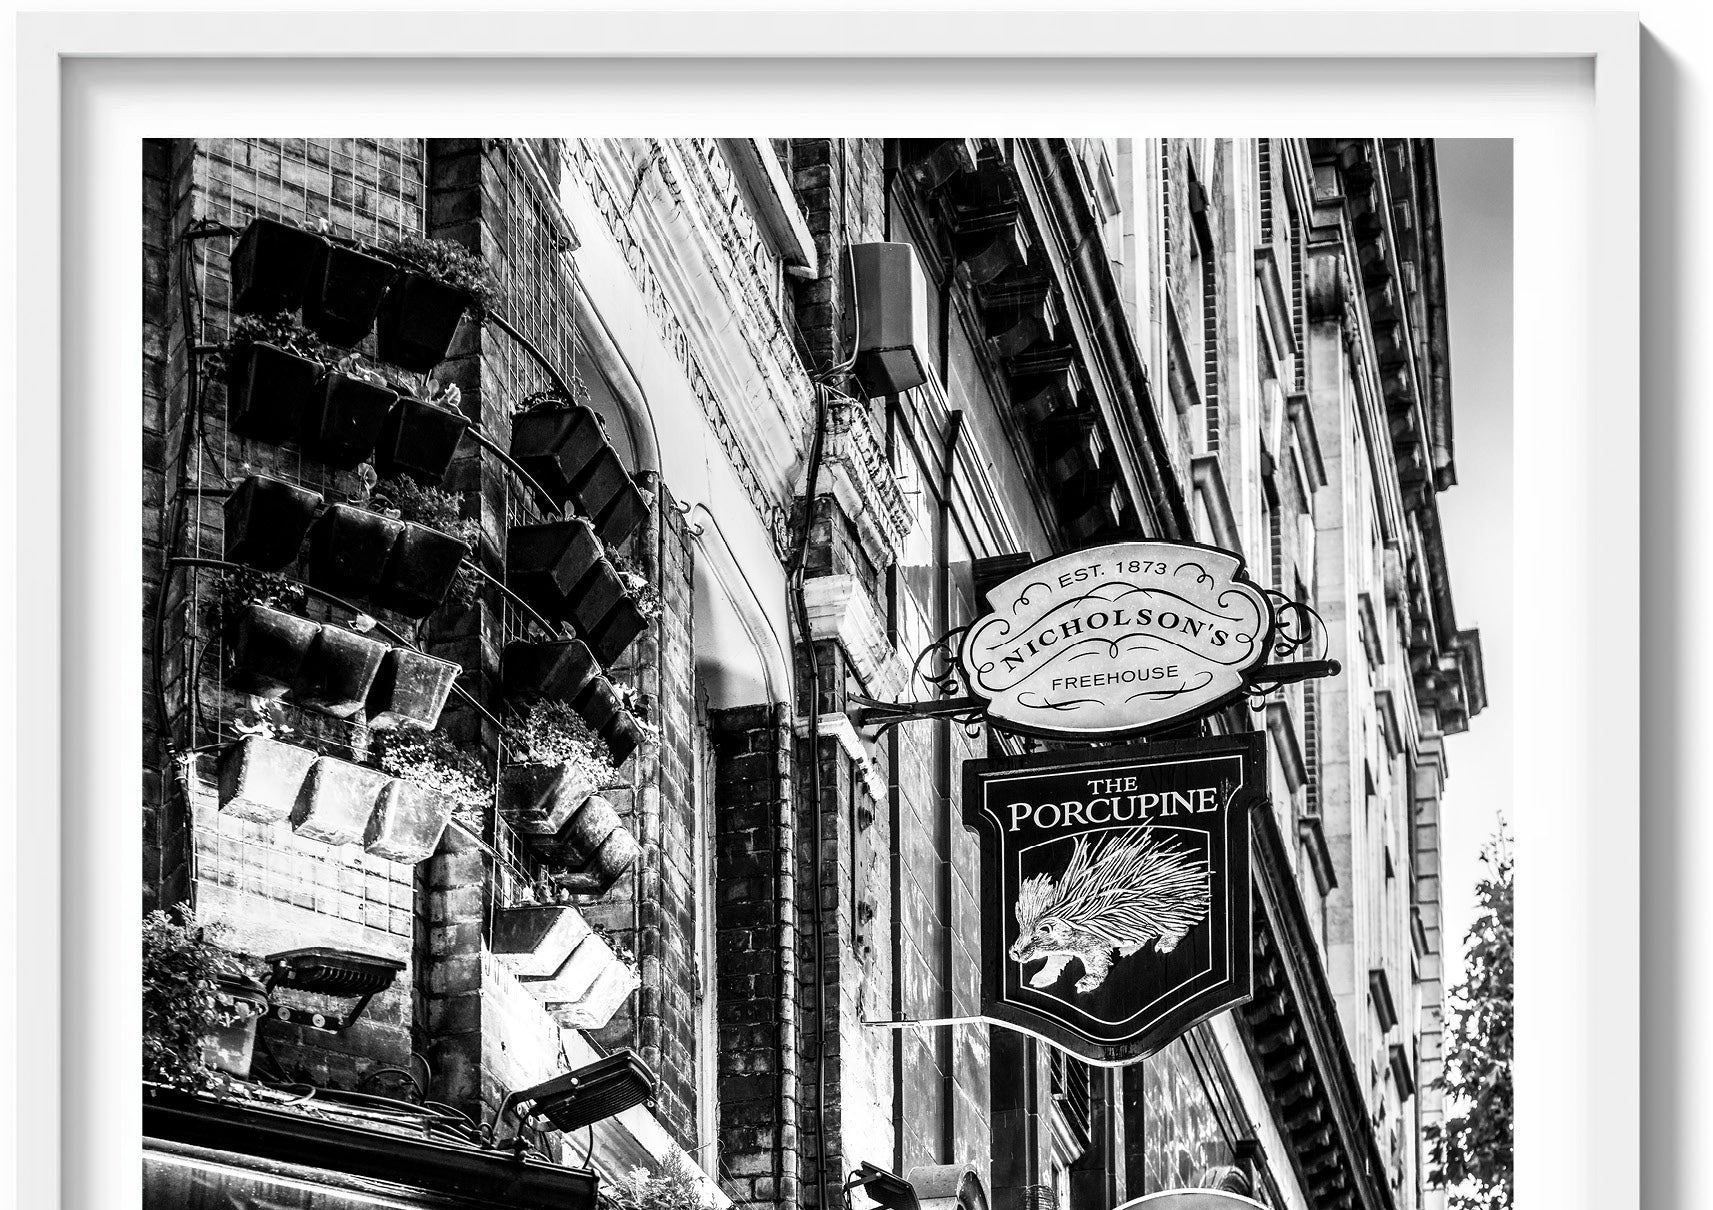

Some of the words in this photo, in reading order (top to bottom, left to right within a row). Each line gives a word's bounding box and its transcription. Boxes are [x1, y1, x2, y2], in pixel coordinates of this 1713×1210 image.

[1058, 564, 1105, 588] EST.
[1115, 560, 1167, 575] 1873
[1001, 608, 1230, 673] NICHOLSON'S
[1052, 665, 1179, 691] FREEHOUSE
[1087, 776, 1138, 796] THE
[1007, 787, 1220, 832] PORCUPINE
